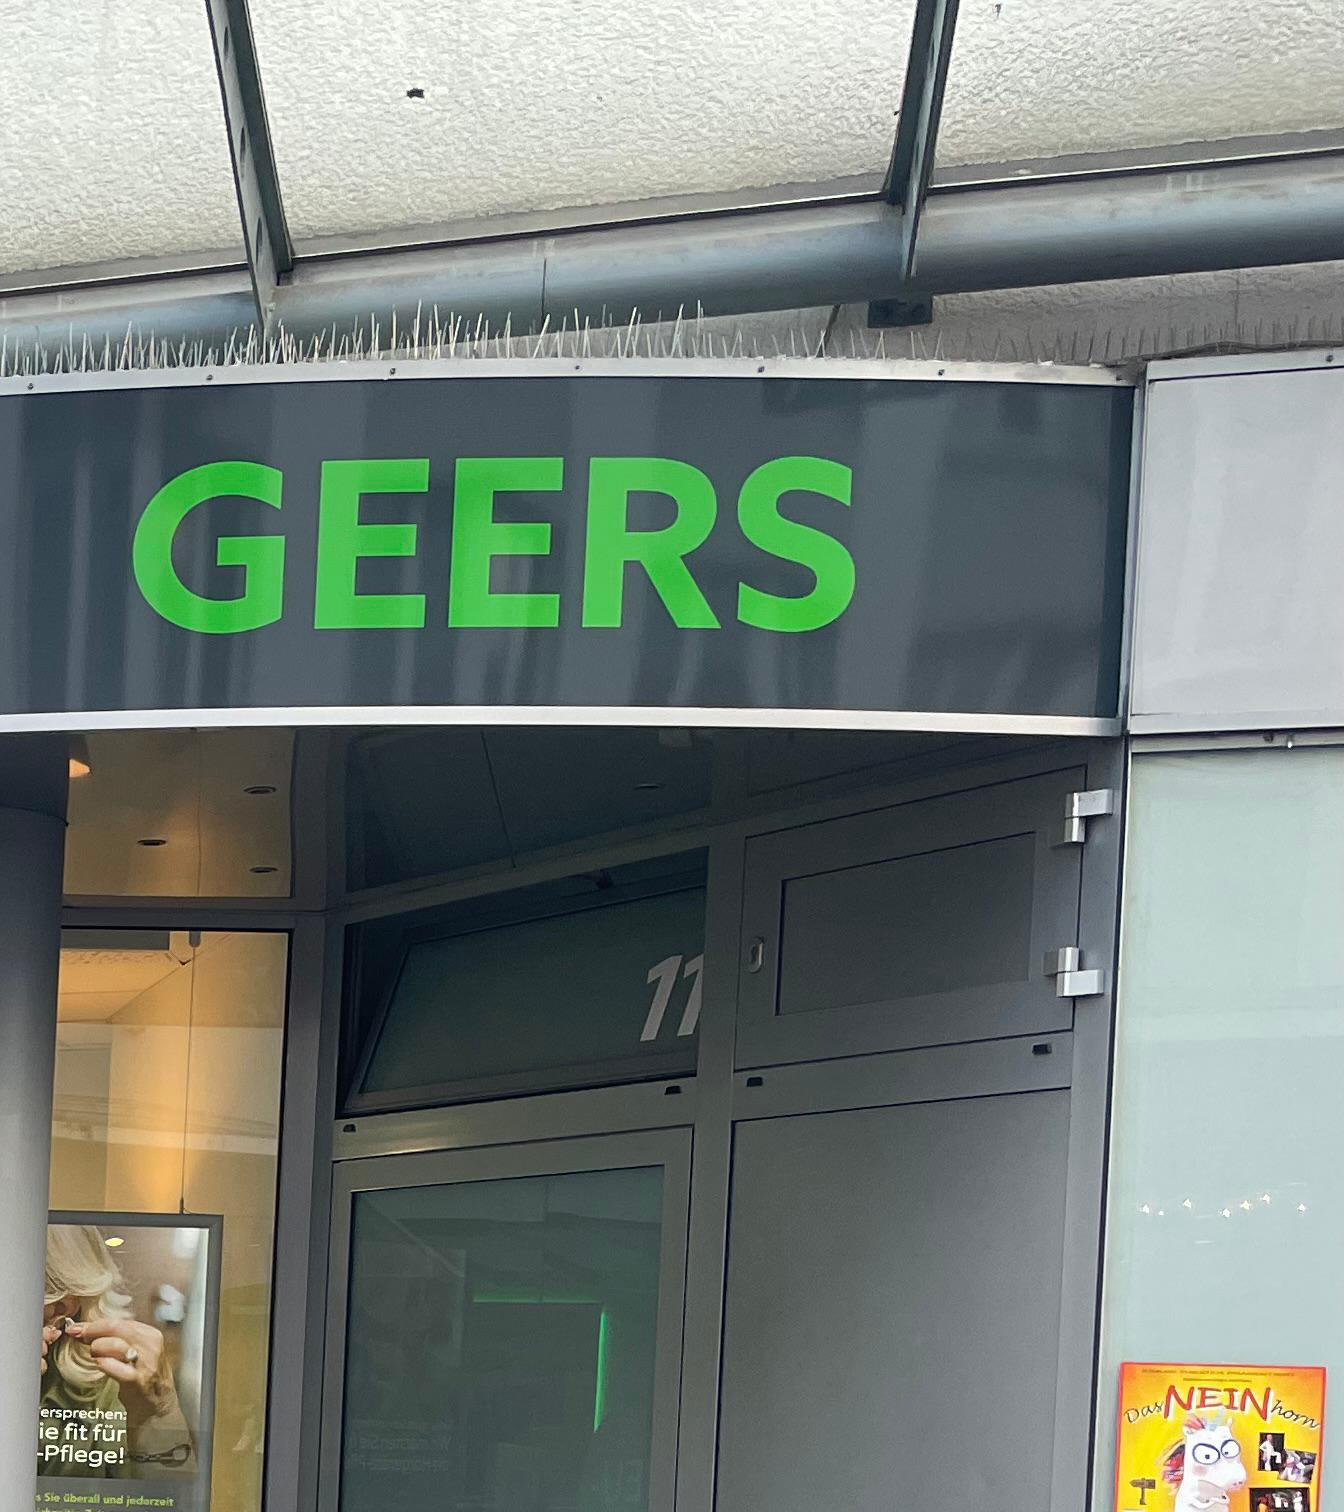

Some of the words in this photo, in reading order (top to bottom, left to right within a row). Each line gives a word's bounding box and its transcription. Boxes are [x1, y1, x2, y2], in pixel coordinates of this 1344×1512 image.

[133, 456, 856, 633] GEERS
[640, 953, 704, 1041] 11
[38, 1407, 128, 1421] ersprechen:
[1124, 1400, 1164, 1425] Das
[64, 1422, 88, 1441] fit
[92, 1424, 127, 1442] für
[44, 1493, 60, 1503] Sie
[63, 1493, 101, 1504] überall
[103, 1495, 124, 1505] und
[126, 1496, 174, 1507] jederzeit
